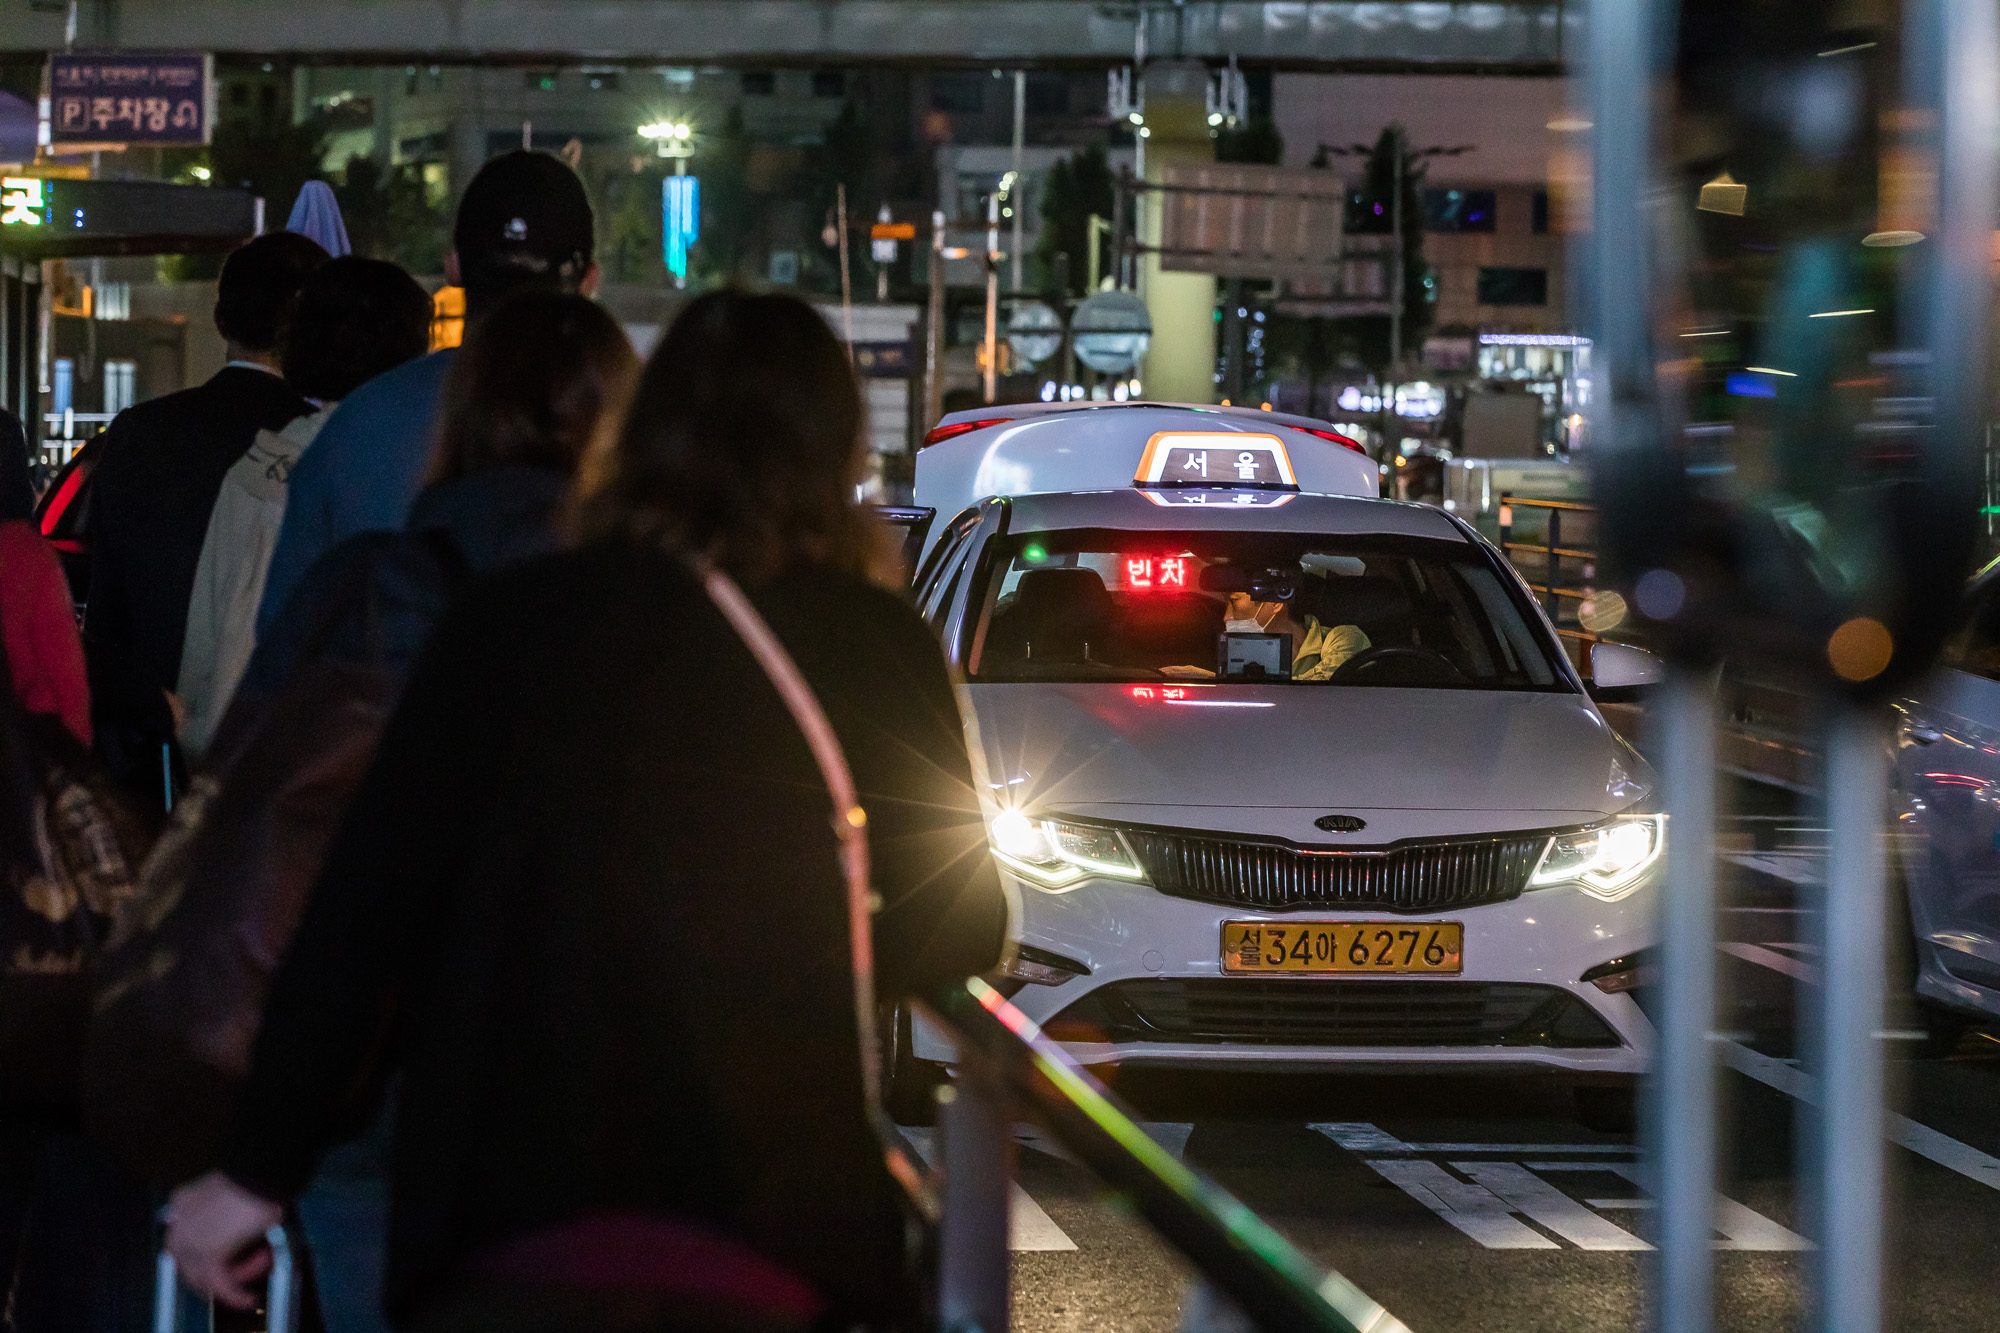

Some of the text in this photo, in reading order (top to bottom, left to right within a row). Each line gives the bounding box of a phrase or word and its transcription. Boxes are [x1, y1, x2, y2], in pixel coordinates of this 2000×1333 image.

[91, 97, 171, 132] 주차장
[1183, 450, 1260, 480] 서울
[1128, 558, 1185, 586] 빈차
[1322, 815, 1360, 828] KIA
[1348, 929, 1445, 966] 6276
